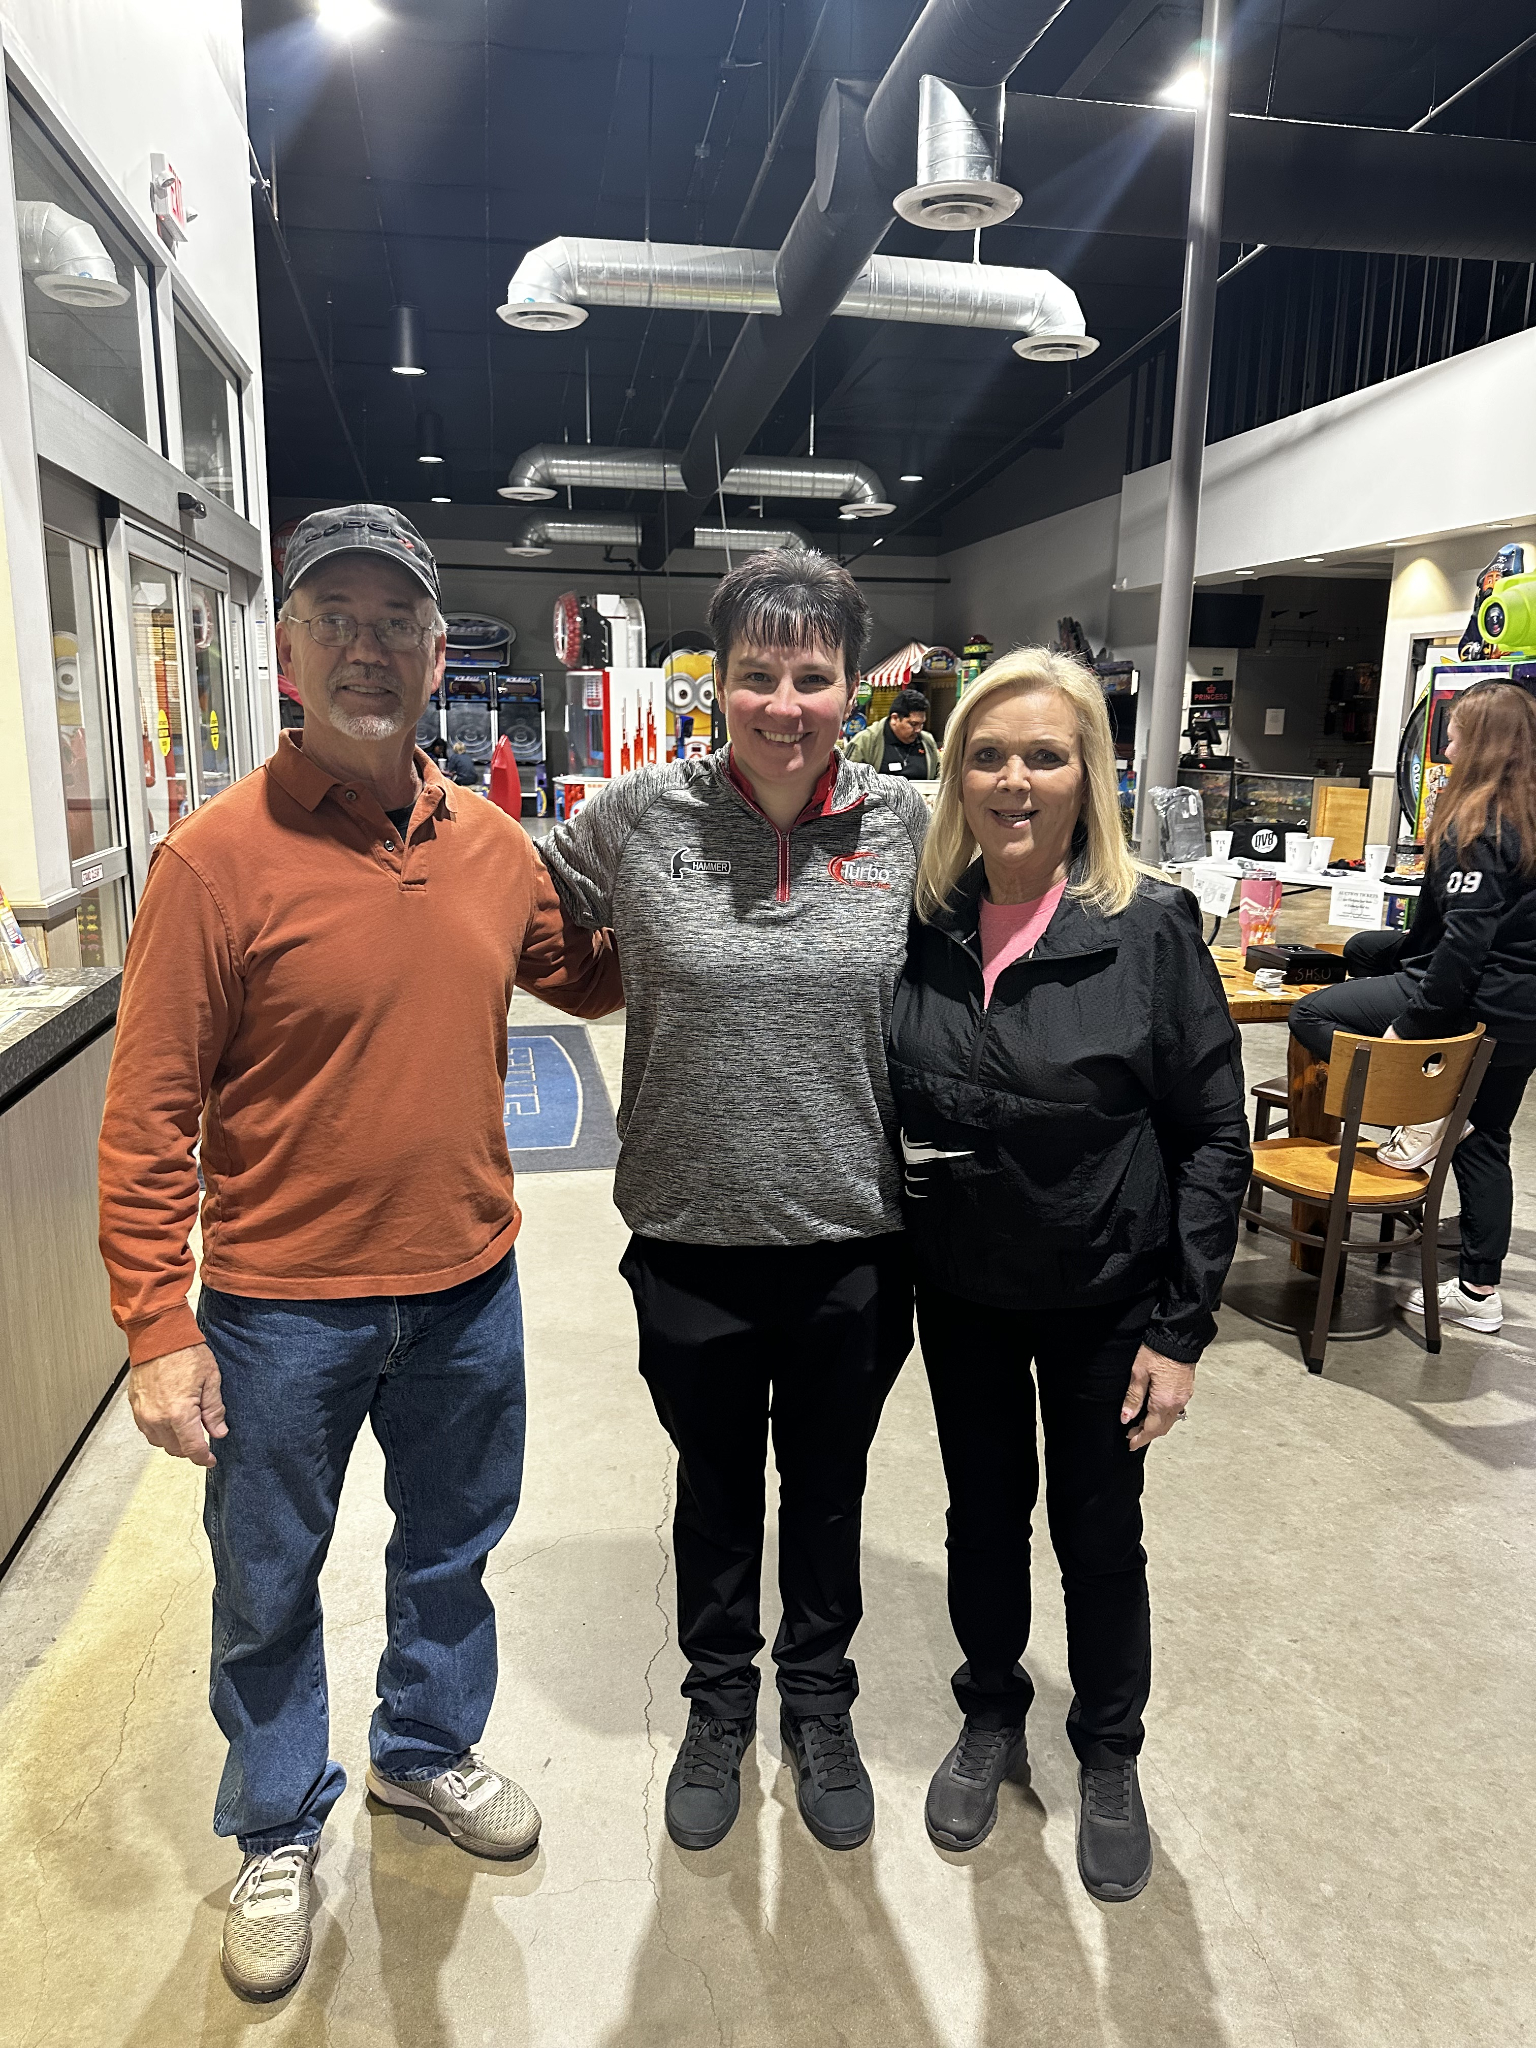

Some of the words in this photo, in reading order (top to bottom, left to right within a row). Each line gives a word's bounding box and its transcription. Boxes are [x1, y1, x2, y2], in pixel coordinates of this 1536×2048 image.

[692, 861, 728, 872] HAMMER
[841, 860, 890, 881] Turbo
[1446, 871, 1483, 894] 09
[1295, 967, 1332, 982] SHSU
